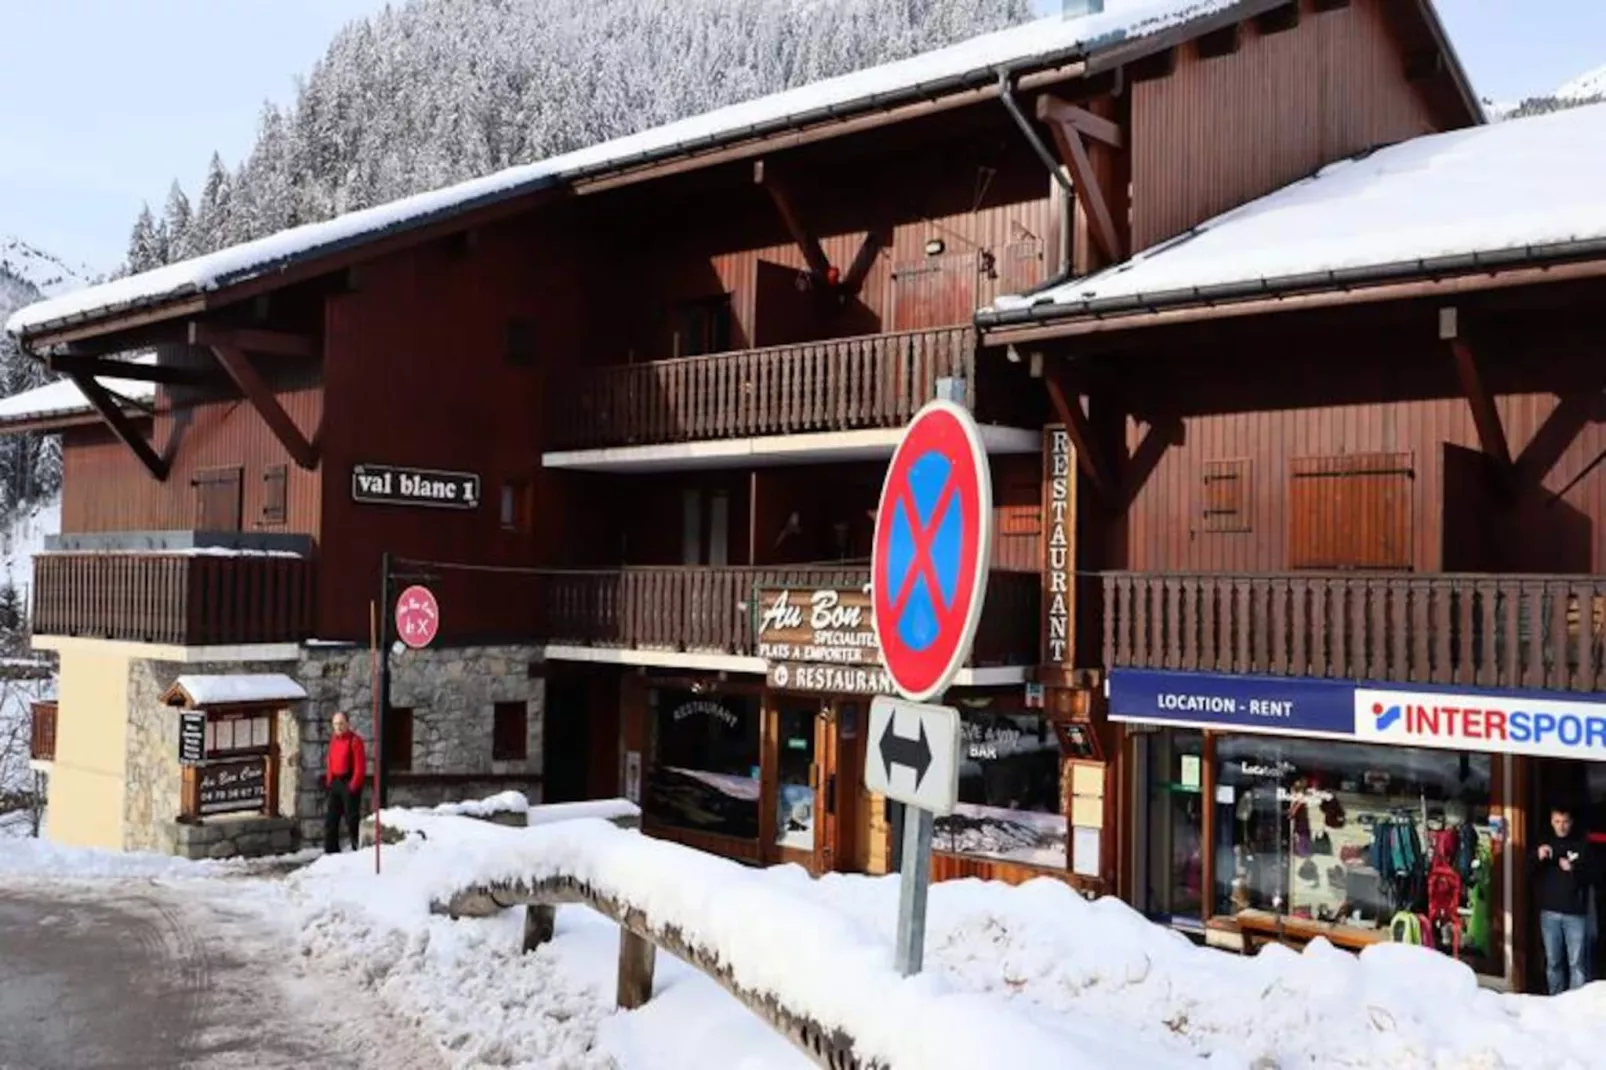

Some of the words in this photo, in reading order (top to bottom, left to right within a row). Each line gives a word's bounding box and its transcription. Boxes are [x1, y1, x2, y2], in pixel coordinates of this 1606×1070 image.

[358, 472, 392, 494] val
[399, 473, 457, 498] blanc
[1050, 431, 1068, 661] RESTAURANT
[759, 589, 802, 634] Au
[810, 590, 862, 629] Bon
[759, 643, 790, 658] PLATS
[804, 646, 862, 660] EMPORTER
[796, 667, 899, 693] RESTAURAN
[673, 701, 738, 728] RESTAURANT
[1157, 693, 1236, 713] LOCATION
[1249, 700, 1293, 717] RENT
[1405, 704, 1606, 747] INTERSPOR
[969, 744, 997, 759] BAR
